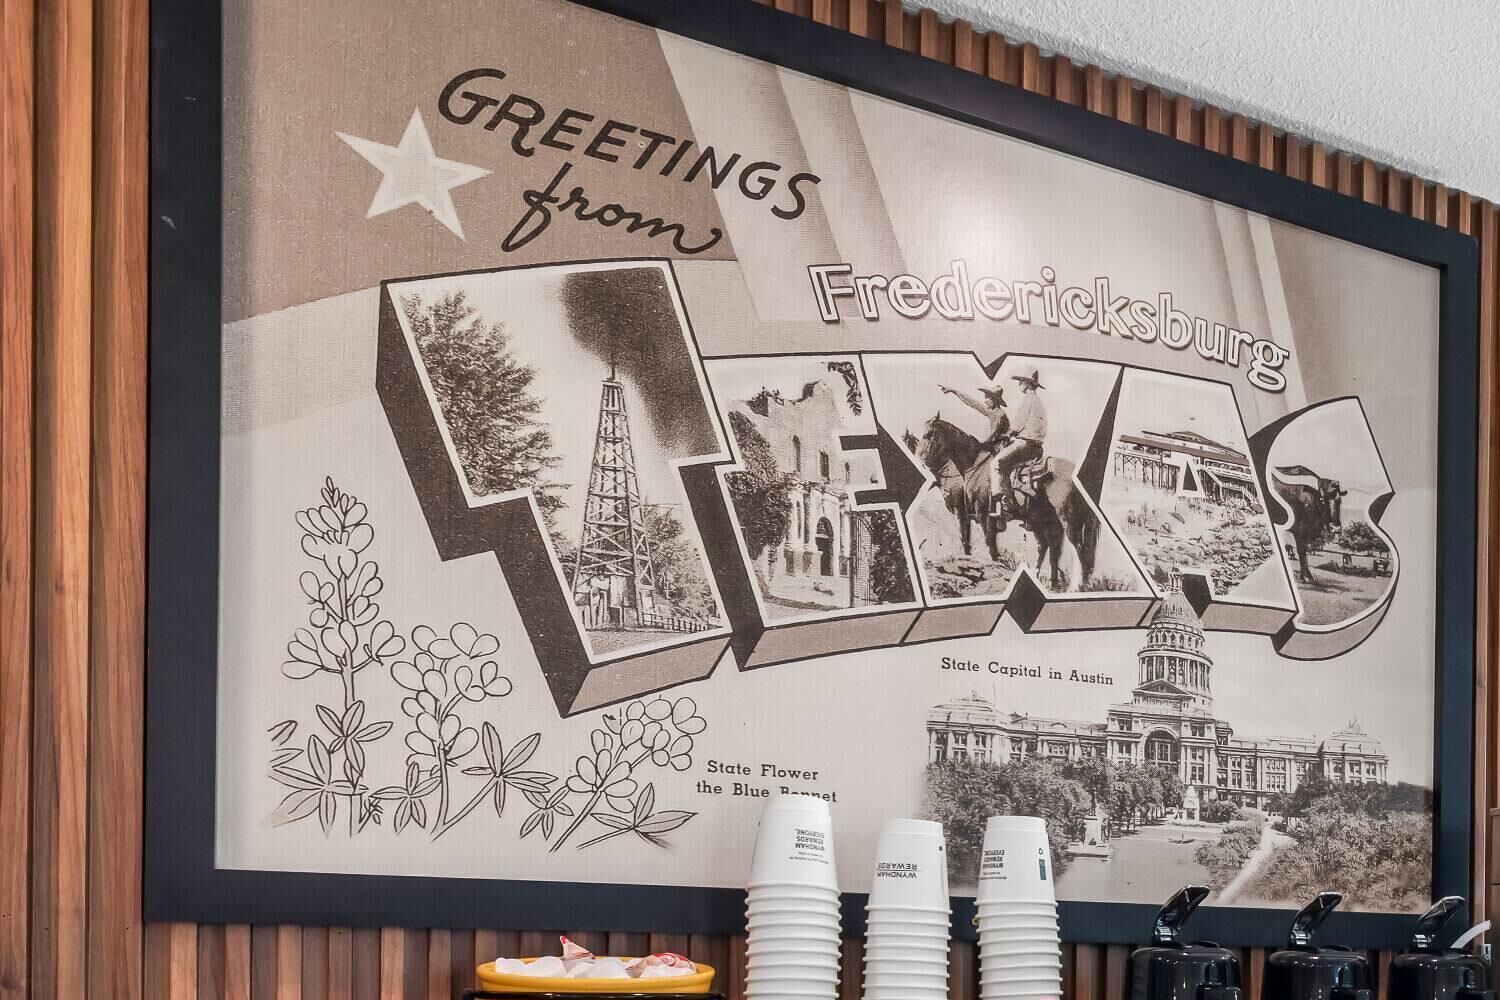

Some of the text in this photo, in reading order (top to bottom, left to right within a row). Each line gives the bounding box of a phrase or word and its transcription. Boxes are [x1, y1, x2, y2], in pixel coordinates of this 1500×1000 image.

[436, 67, 821, 221] GREETINGS
[501, 162, 724, 254] from
[807, 259, 1289, 394] Fredericksburg
[375, 258, 1402, 719] TEXAS
[941, 656, 1114, 685] State Capital in Austin
[707, 759, 819, 780] State Flower
[696, 780, 723, 794] the
[732, 782, 770, 798] Blue
[795, 842, 825, 852] WYNDHAM
[876, 871, 917, 879] WYNDHAM
[877, 862, 917, 870] REWARDS
